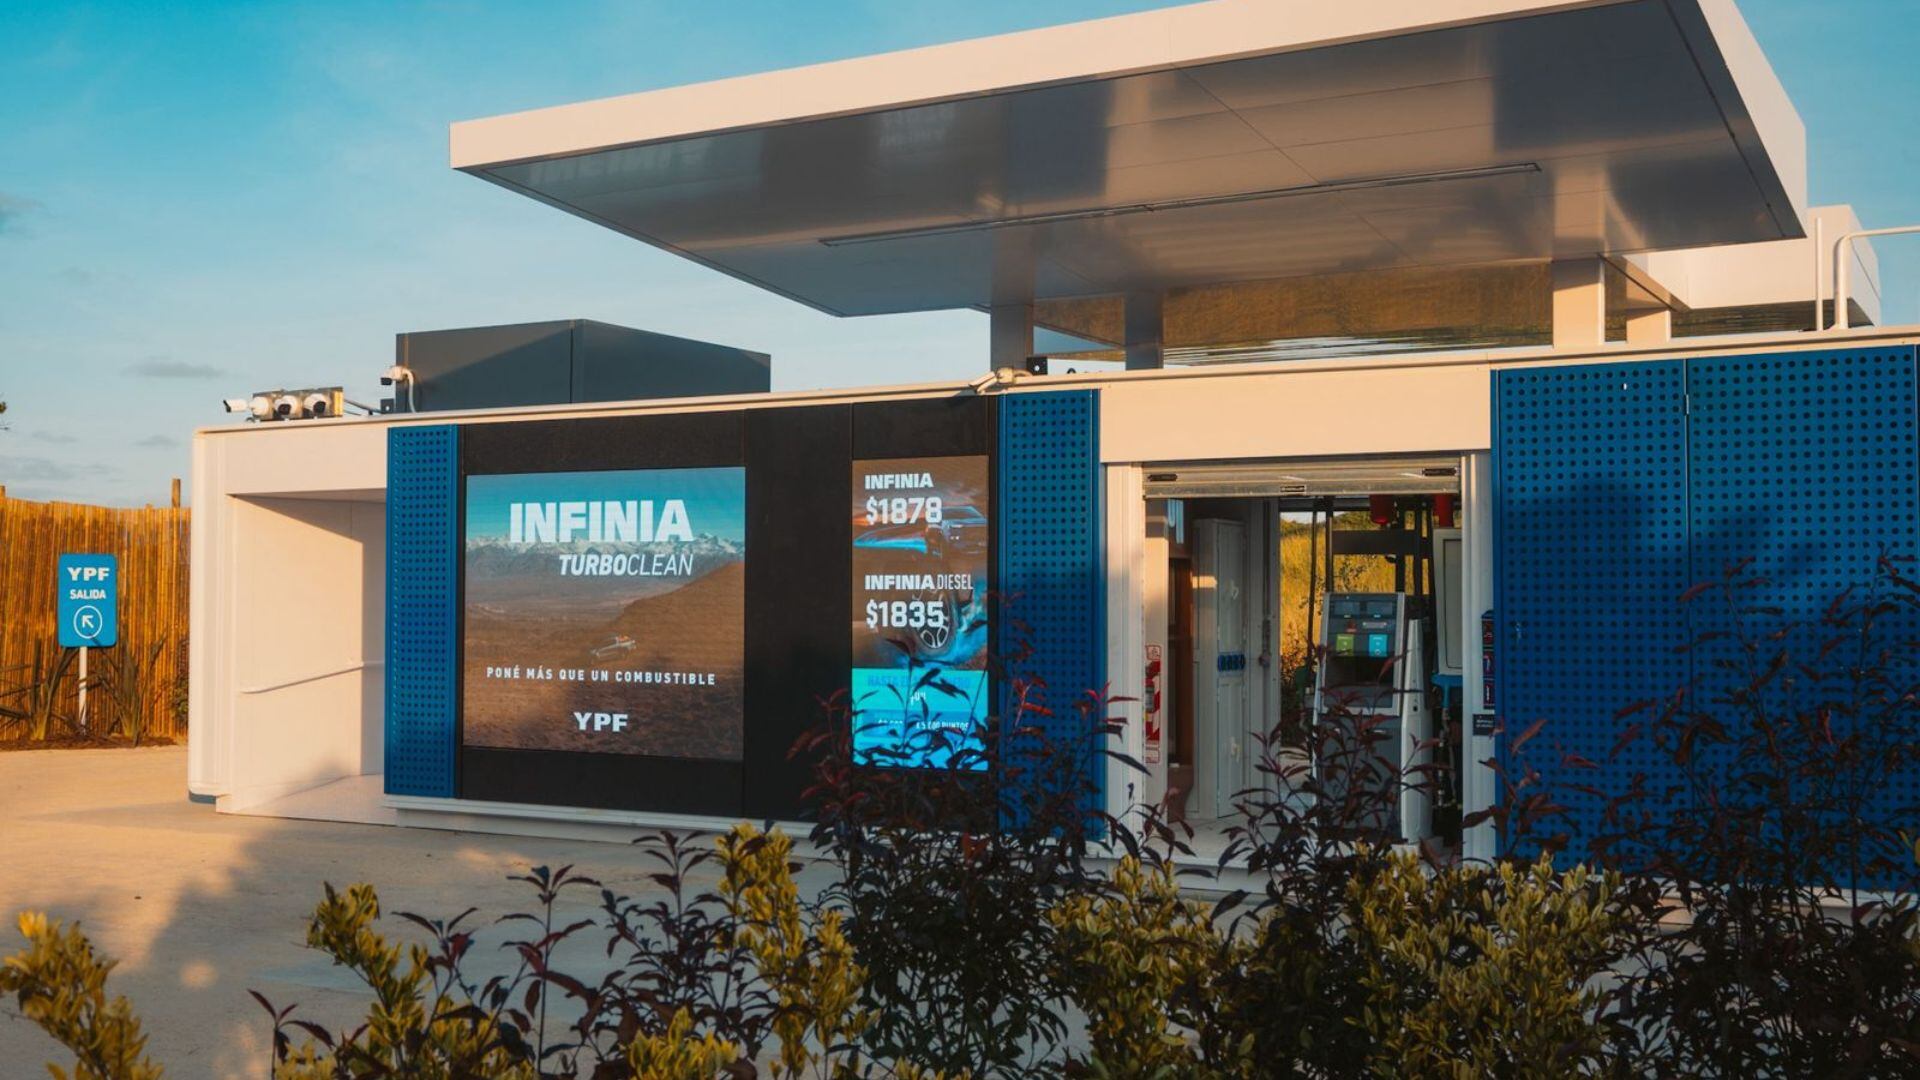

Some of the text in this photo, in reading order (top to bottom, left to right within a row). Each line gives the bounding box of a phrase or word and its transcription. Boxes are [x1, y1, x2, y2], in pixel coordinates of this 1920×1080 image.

[864, 473, 934, 489] INFINIA
[510, 499, 694, 543] INFINIA
[866, 496, 943, 526] $1878
[67, 567, 110, 581] YPF
[559, 553, 693, 576] TURBOCLEAN
[864, 574, 974, 590] INFINIA DIESEL
[70, 589, 107, 600] SALIDA
[866, 599, 944, 629] $1835
[486, 664, 716, 686] PONÉ MÁS QUE UN COMBUSTIBLE
[574, 712, 629, 733] YPF
